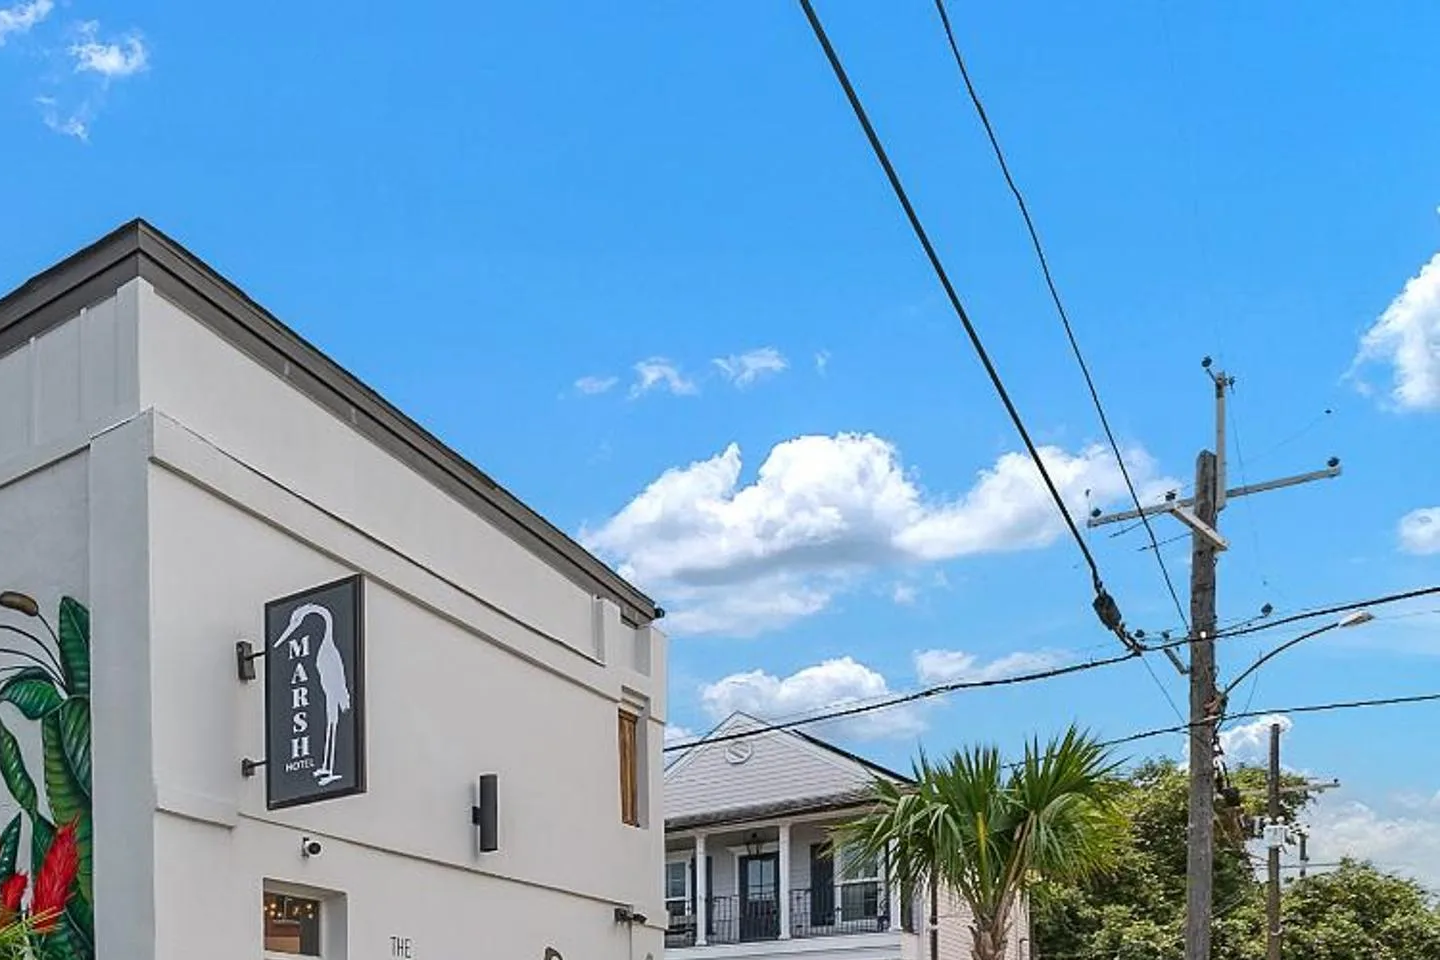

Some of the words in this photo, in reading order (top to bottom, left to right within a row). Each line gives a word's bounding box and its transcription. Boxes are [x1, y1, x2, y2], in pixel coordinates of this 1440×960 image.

[288, 634, 311, 759] MARSH
[285, 758, 315, 773] HOTEL
[389, 936, 412, 959] THE
